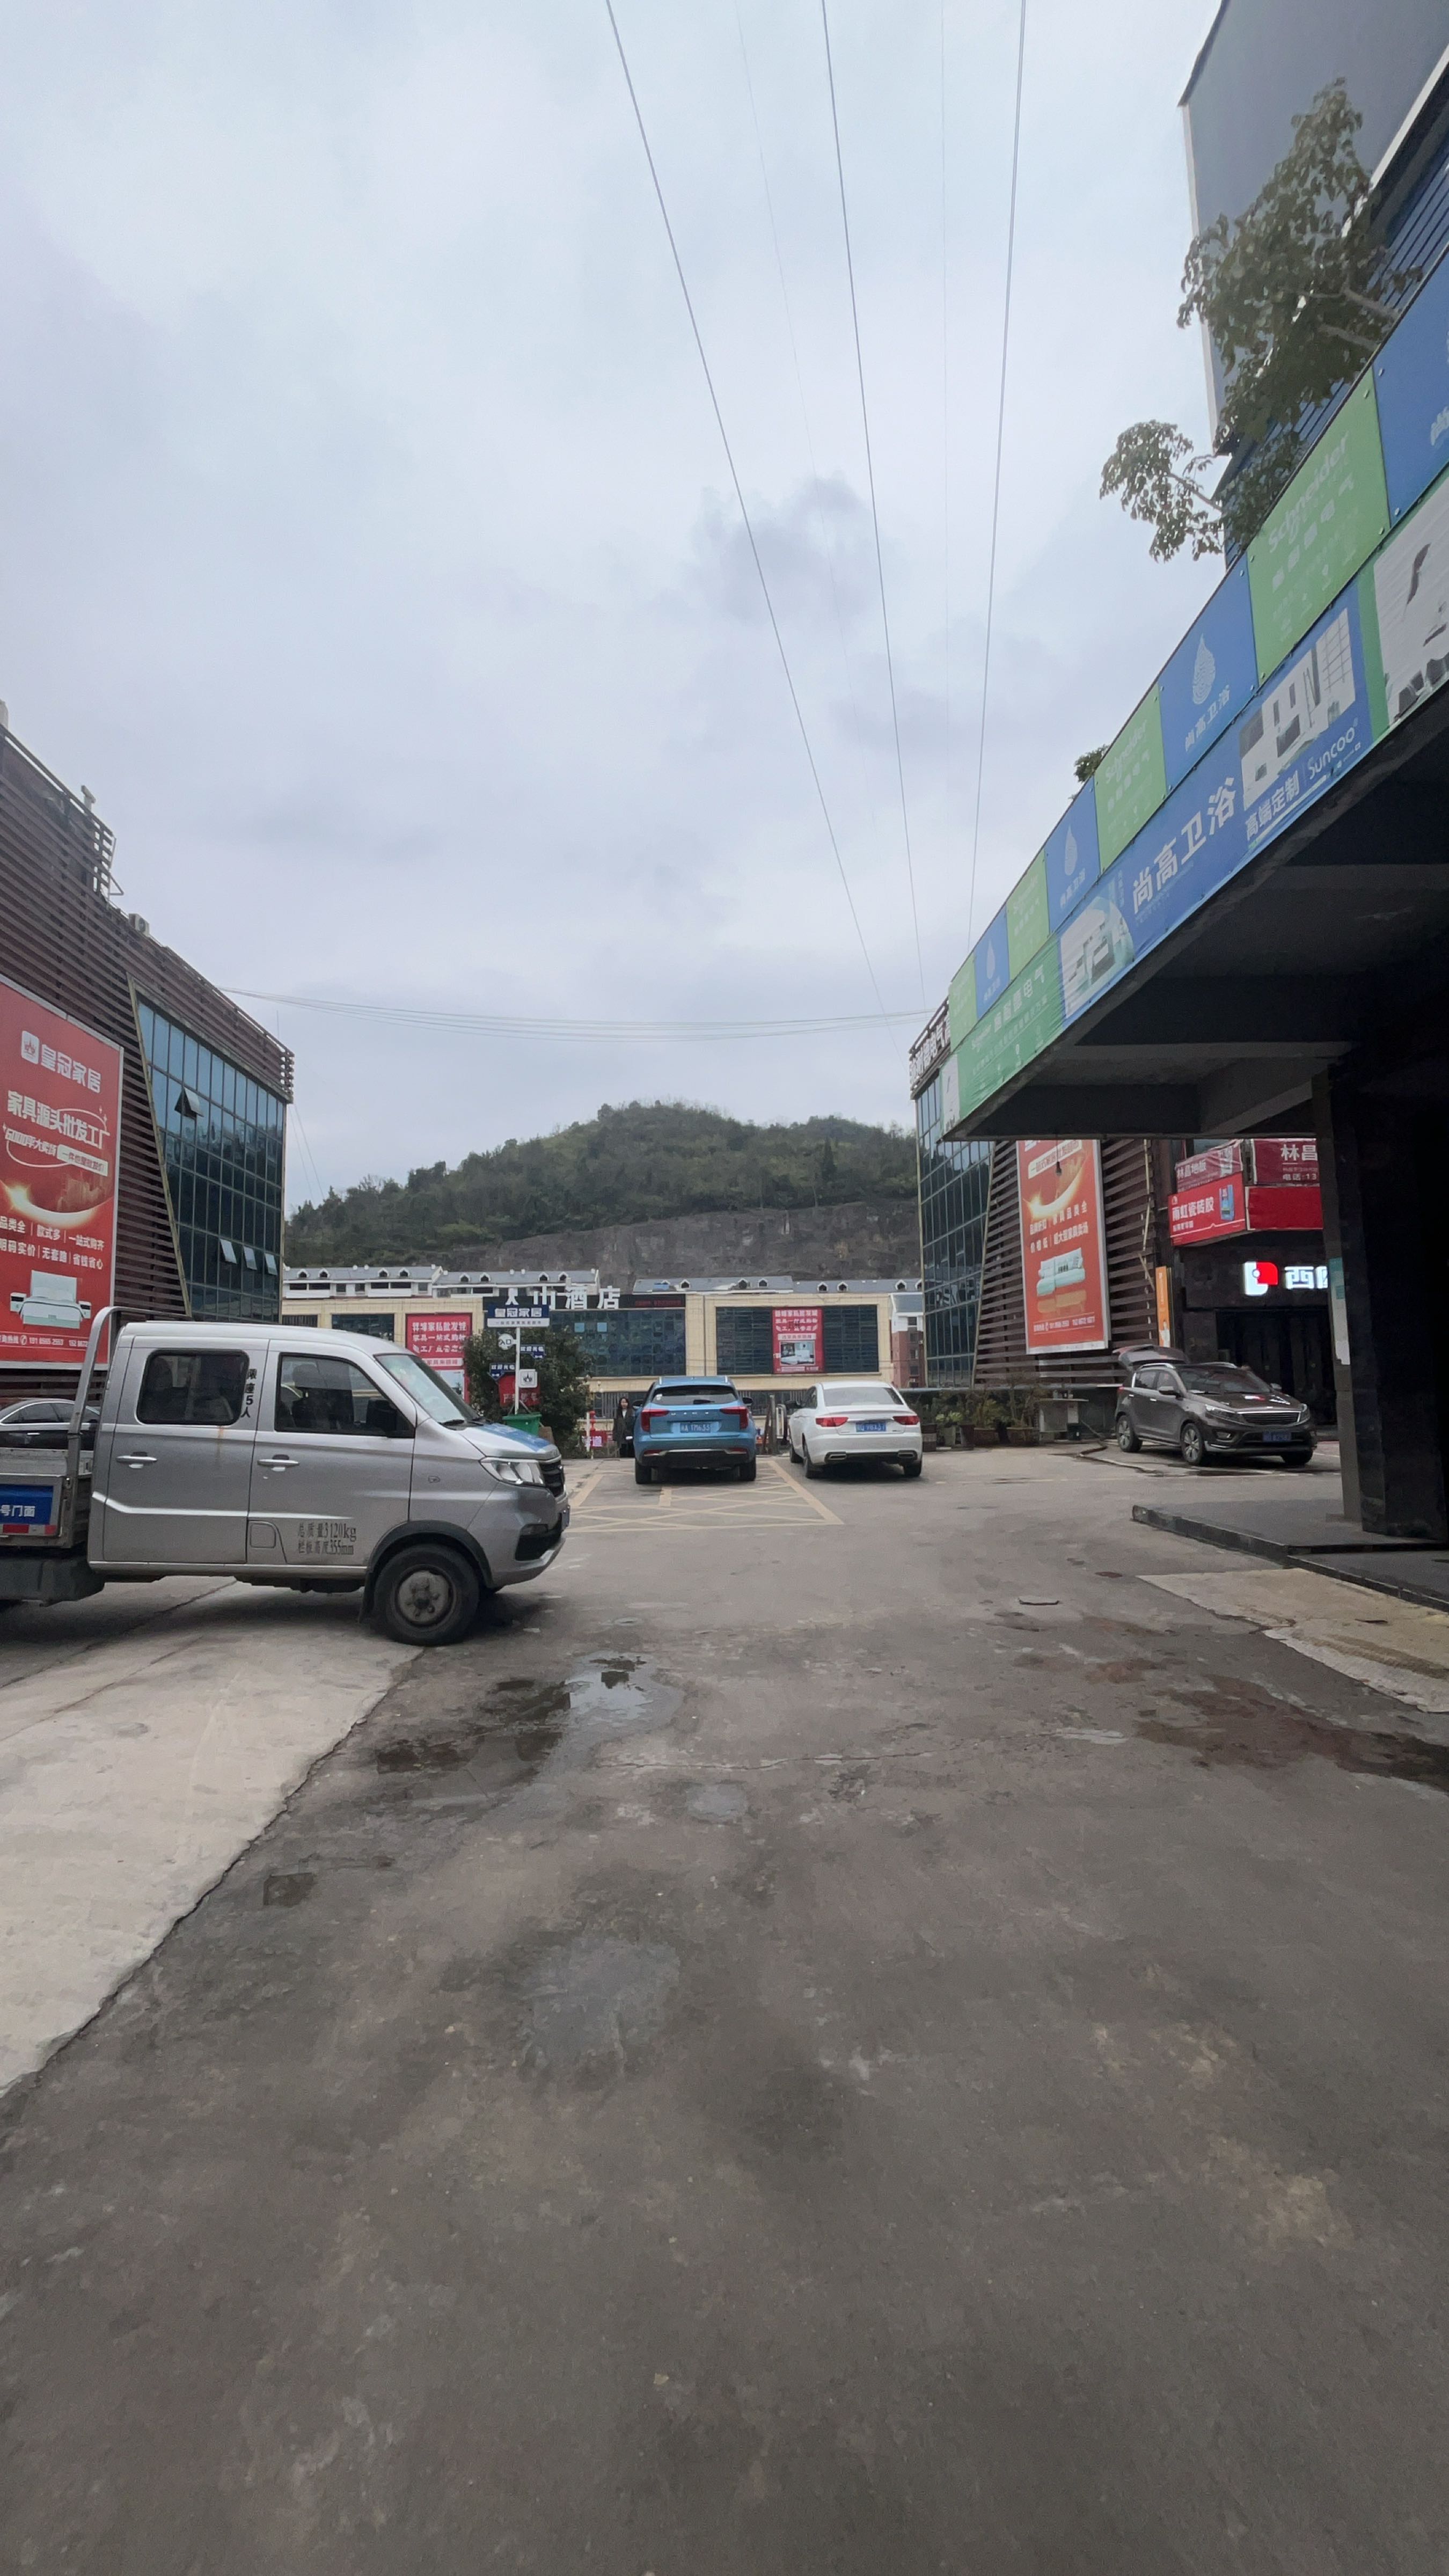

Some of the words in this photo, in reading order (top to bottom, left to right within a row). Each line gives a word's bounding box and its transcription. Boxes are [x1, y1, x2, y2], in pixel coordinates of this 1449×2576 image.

[1185, 684, 1230, 752] 尚高卫浴
[1245, 770, 1300, 841] 高端定制
[1307, 727, 1355, 780] Suncoo
[1133, 777, 1236, 914] 尚高卫浴
[40, 1044, 101, 1093] 皇冠家居
[8, 1090, 111, 1149] 家具源头批发工厂
[1280, 1144, 1318, 1161] 林昌
[36, 1224, 61, 1241] 款式多
[68, 1234, 105, 1252] 一站式购齐
[73, 1253, 104, 1270] 省钱省心
[0, 1505, 35, 1517] 号门面
